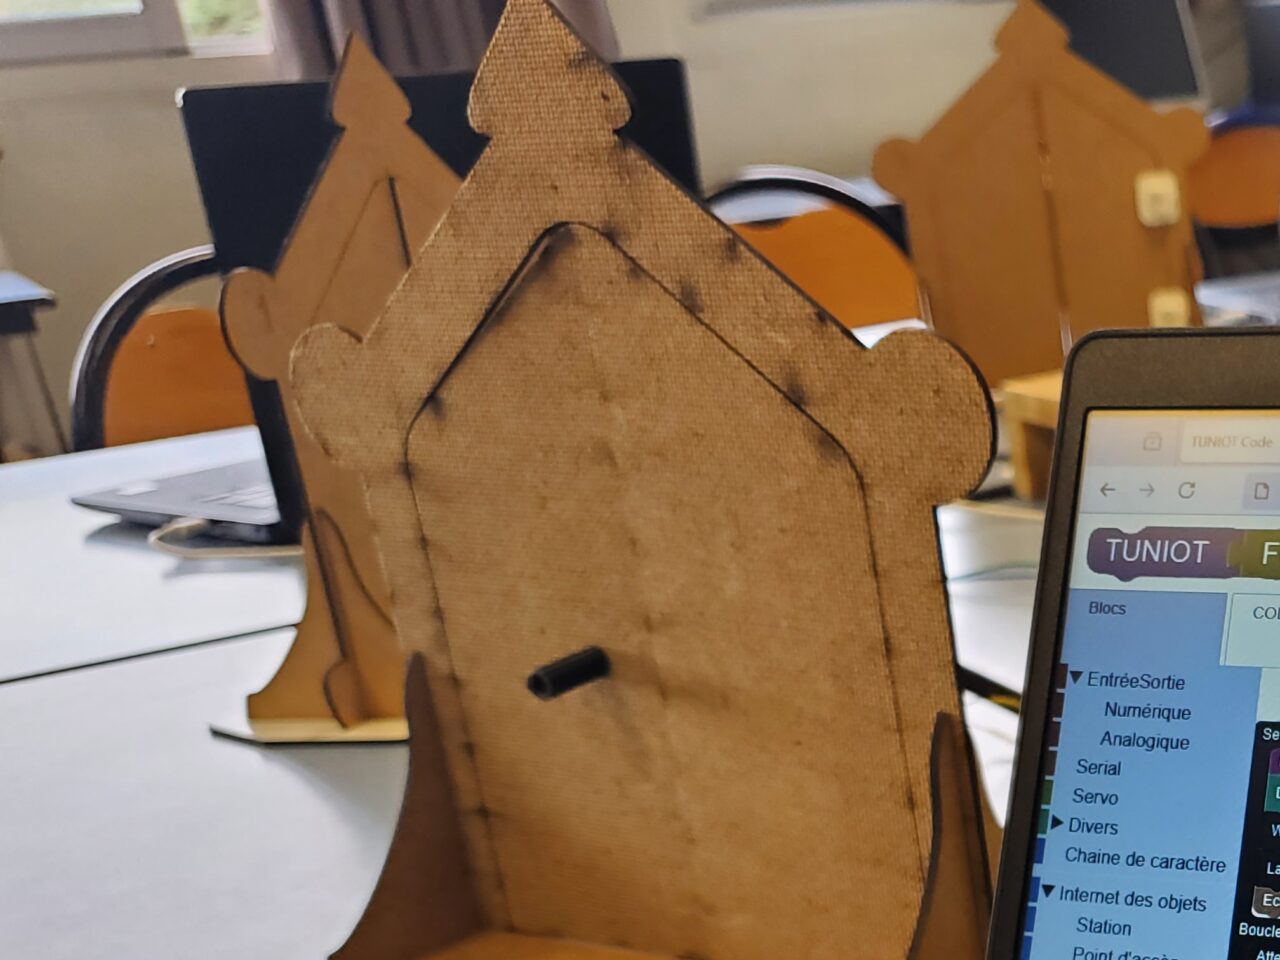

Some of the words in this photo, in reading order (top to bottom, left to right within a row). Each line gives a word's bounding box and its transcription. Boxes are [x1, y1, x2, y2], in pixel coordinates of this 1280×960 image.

[1240, 436, 1273, 448] Code
[1107, 538, 1209, 563] TUNIOT
[1089, 601, 1126, 616] Blocs
[1088, 671, 1185, 690] EntréeSortie
[1104, 702, 1191, 722] Numérique
[1100, 730, 1190, 752] Analogique
[1076, 759, 1121, 776] Serial
[1073, 788, 1119, 806] Servo
[1069, 817, 1118, 835] Divers
[1065, 847, 1120, 865] Chaine
[1126, 852, 1145, 867] de
[1151, 854, 1226, 872] caractère
[1060, 886, 1119, 905] Internet
[1125, 890, 1152, 908] des
[1158, 894, 1207, 913] objets
[1077, 916, 1132, 936] Station
